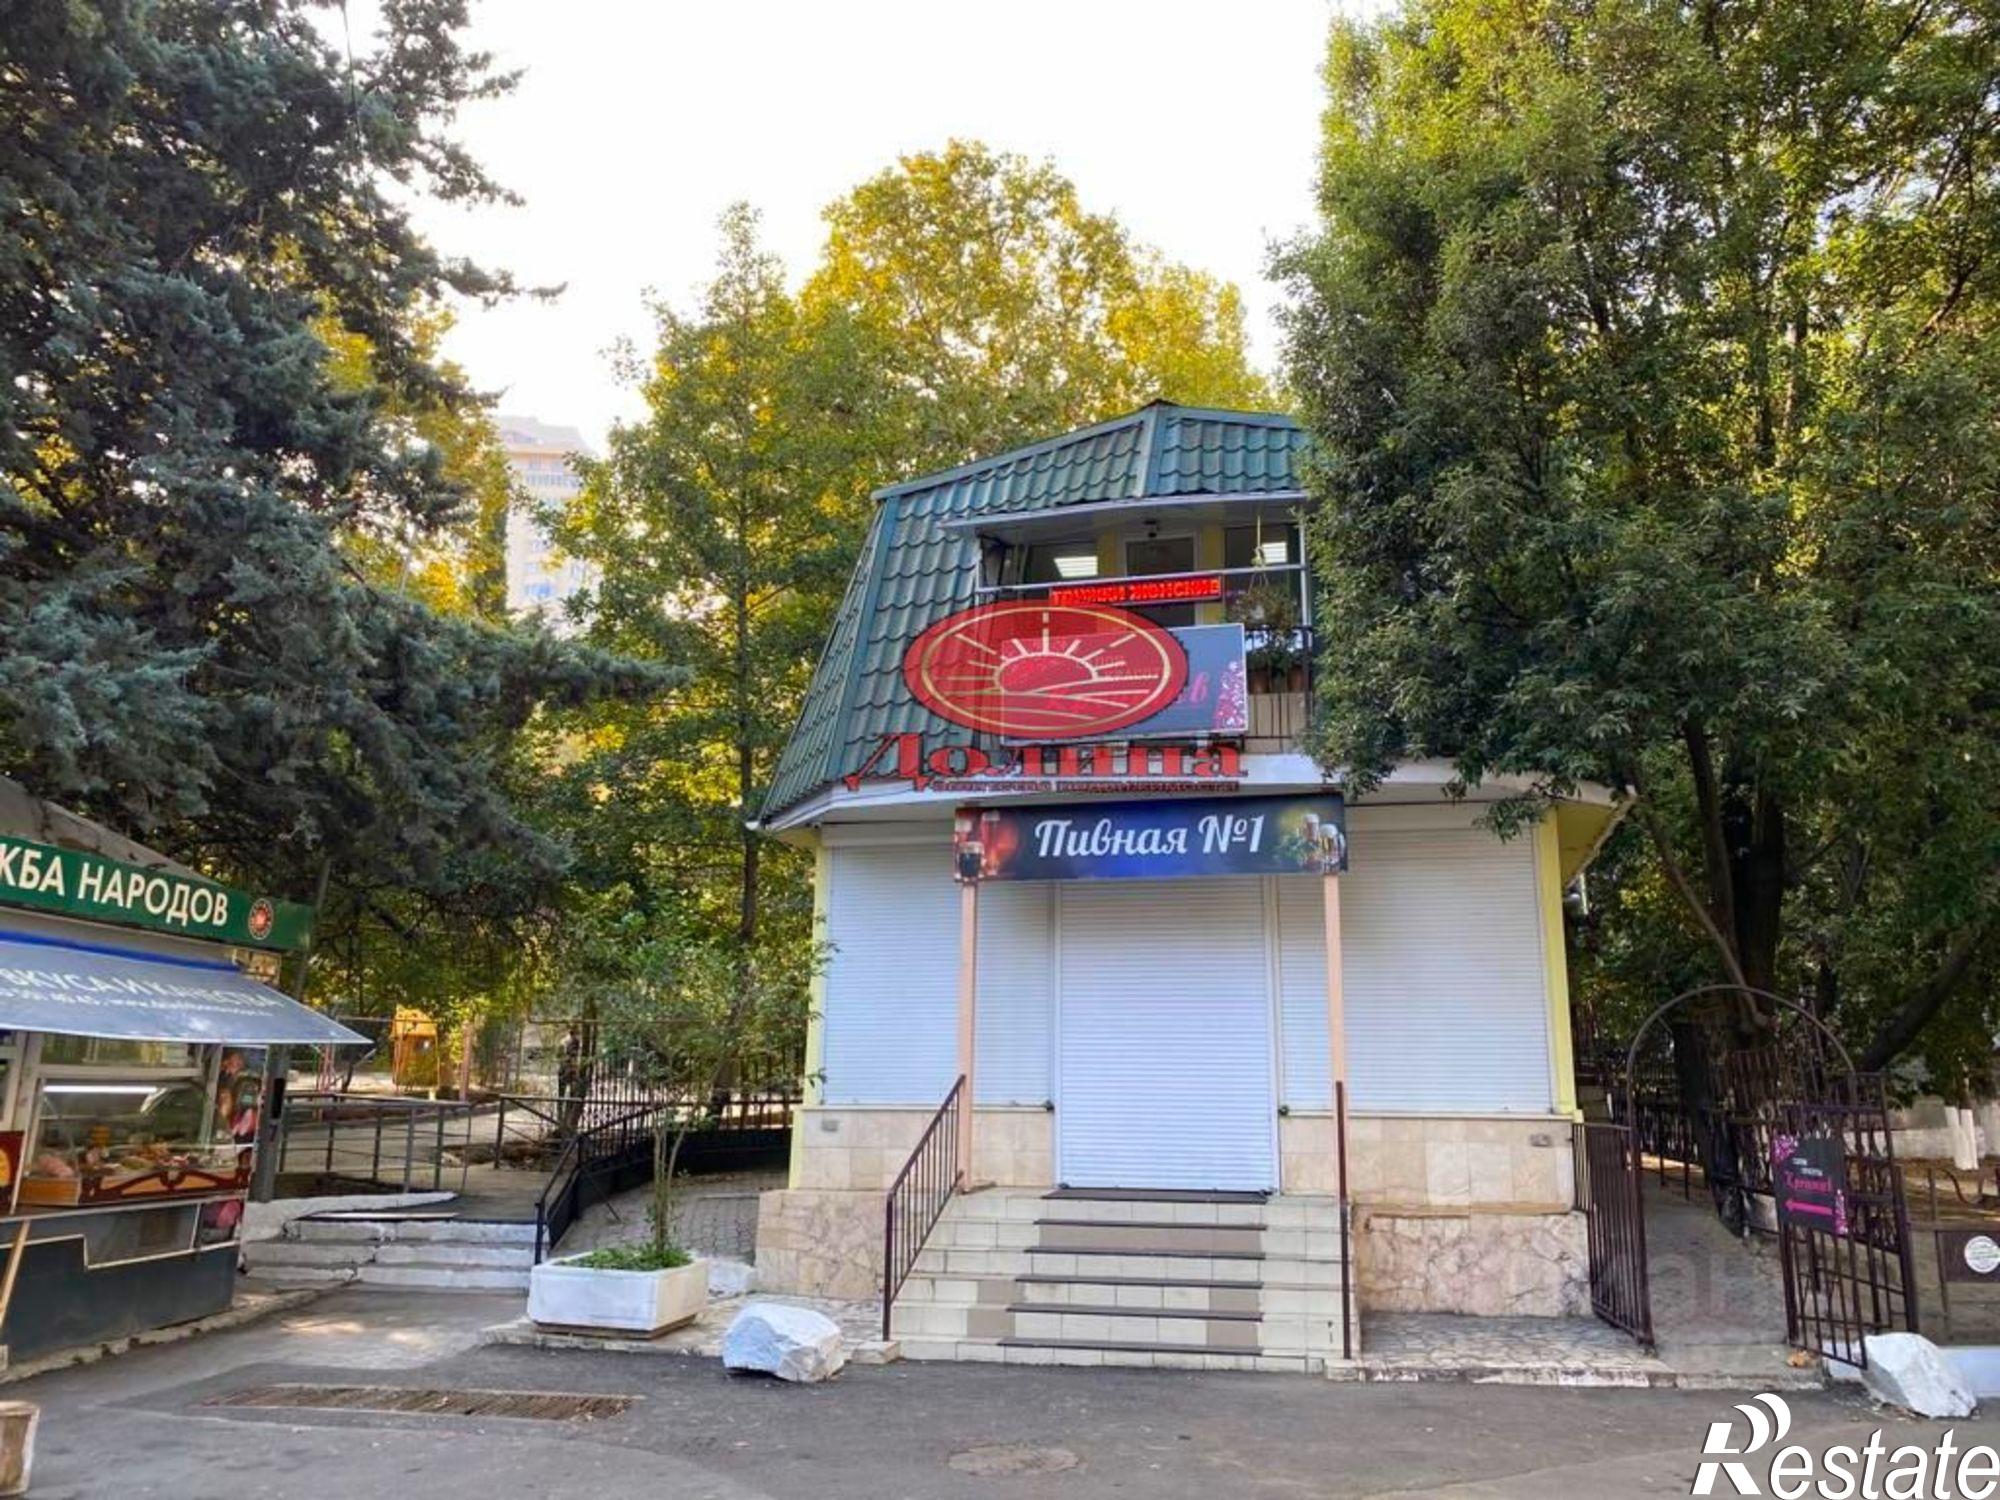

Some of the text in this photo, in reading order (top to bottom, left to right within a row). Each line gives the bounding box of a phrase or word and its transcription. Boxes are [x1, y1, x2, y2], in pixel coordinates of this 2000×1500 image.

[1034, 814, 1265, 857] Пивная №1
[77, 861, 229, 927] НАРОДОВ
